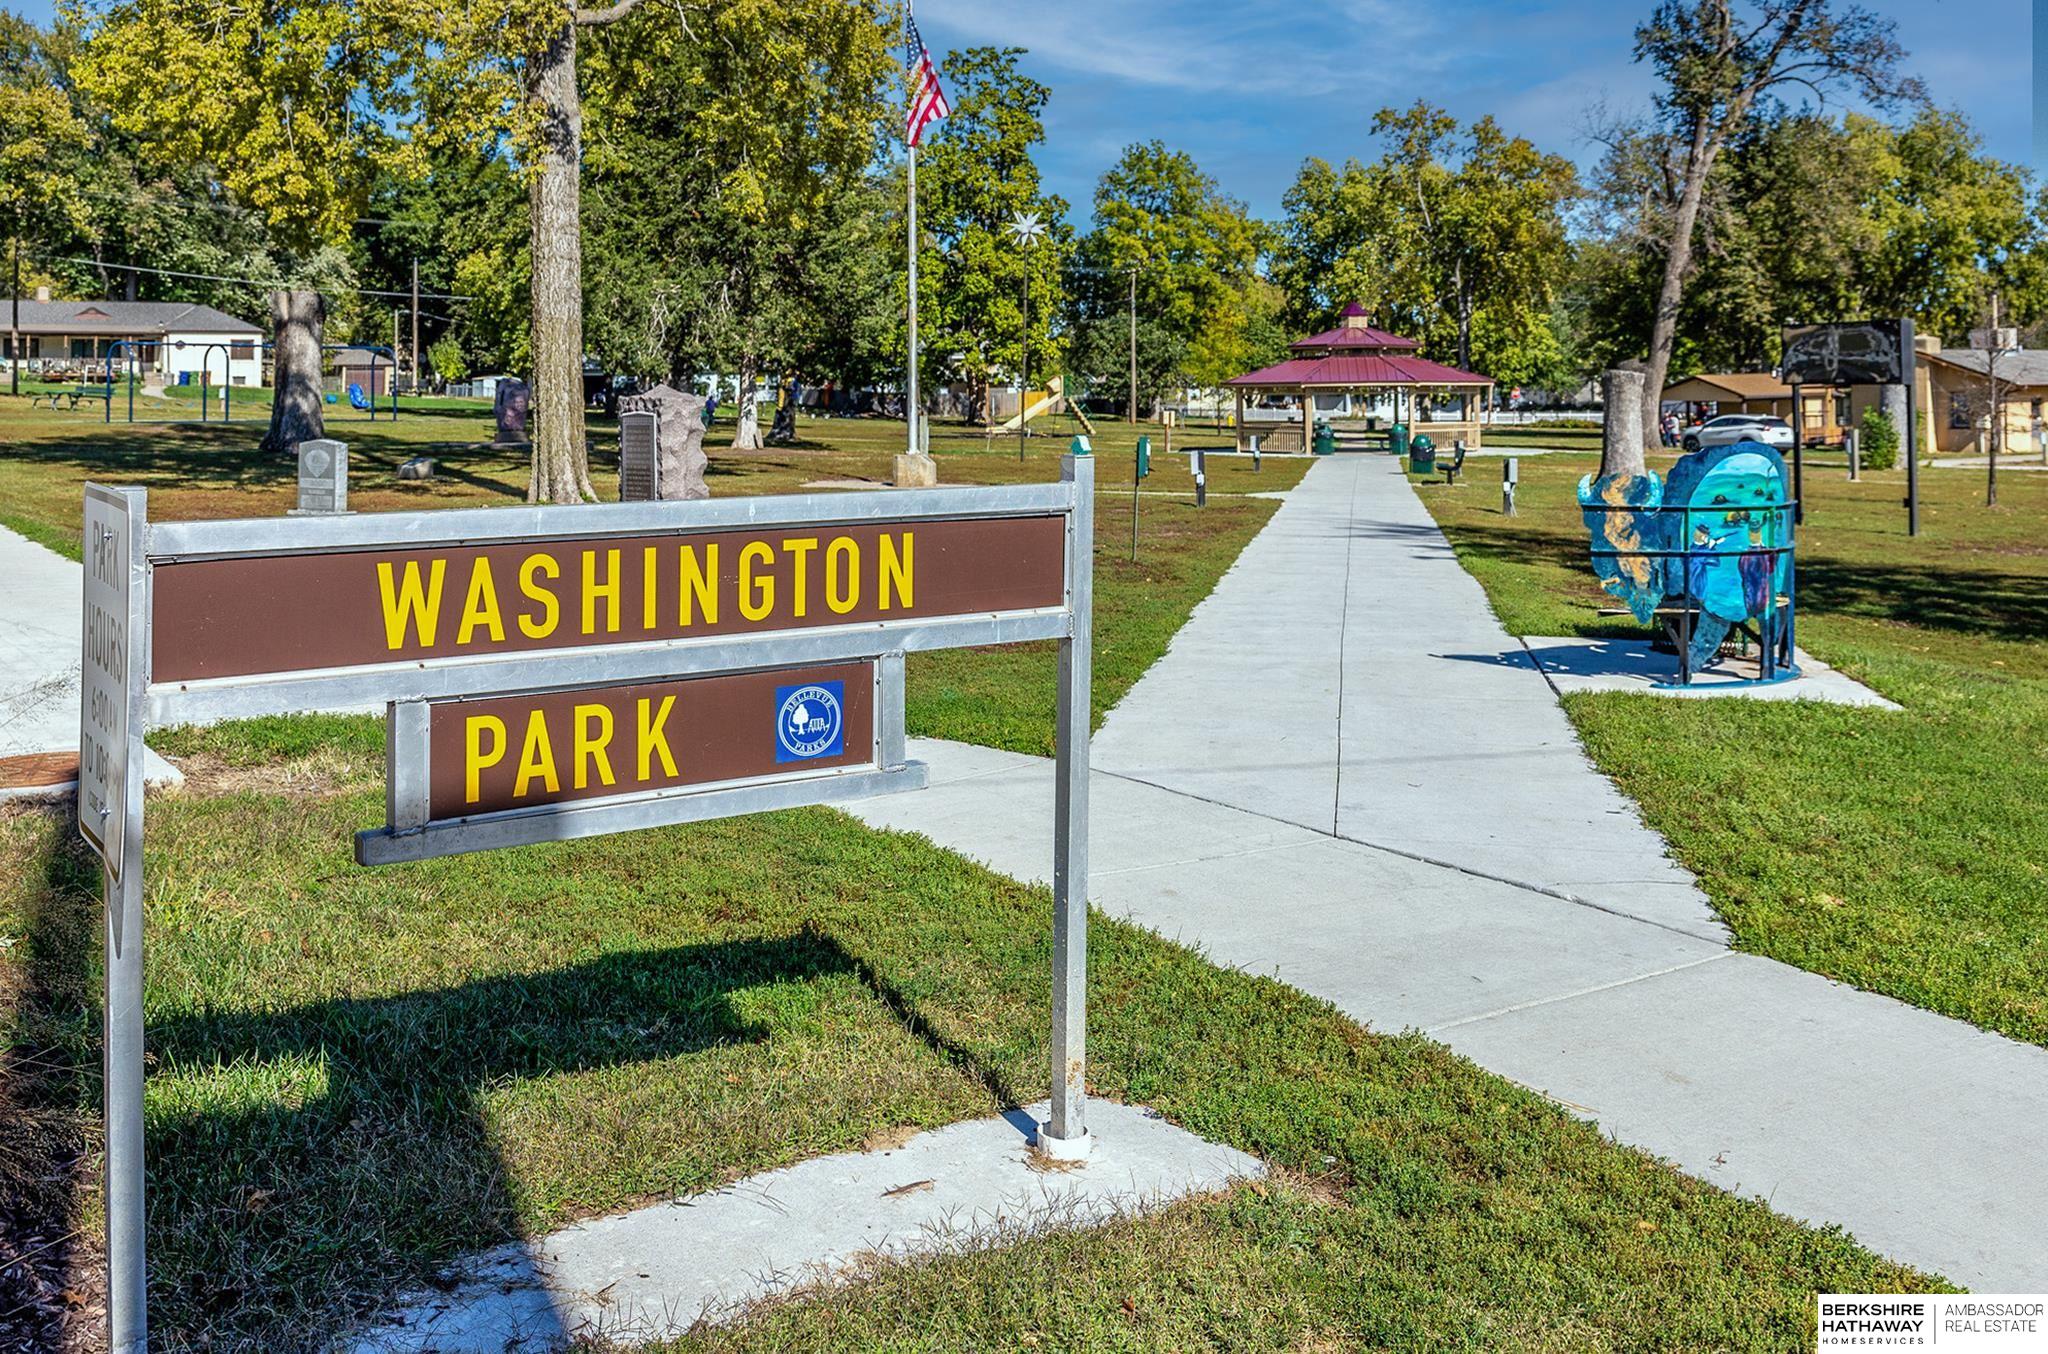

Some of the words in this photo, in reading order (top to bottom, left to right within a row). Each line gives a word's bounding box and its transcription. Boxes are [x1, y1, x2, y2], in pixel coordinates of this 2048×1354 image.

[93, 520, 119, 592] PARK
[376, 531, 914, 651] WASHINGTON
[88, 601, 123, 684] HOURS
[786, 691, 834, 712] BELLEVUE
[465, 695, 679, 803] PARK
[794, 738, 826, 753] PARKS
